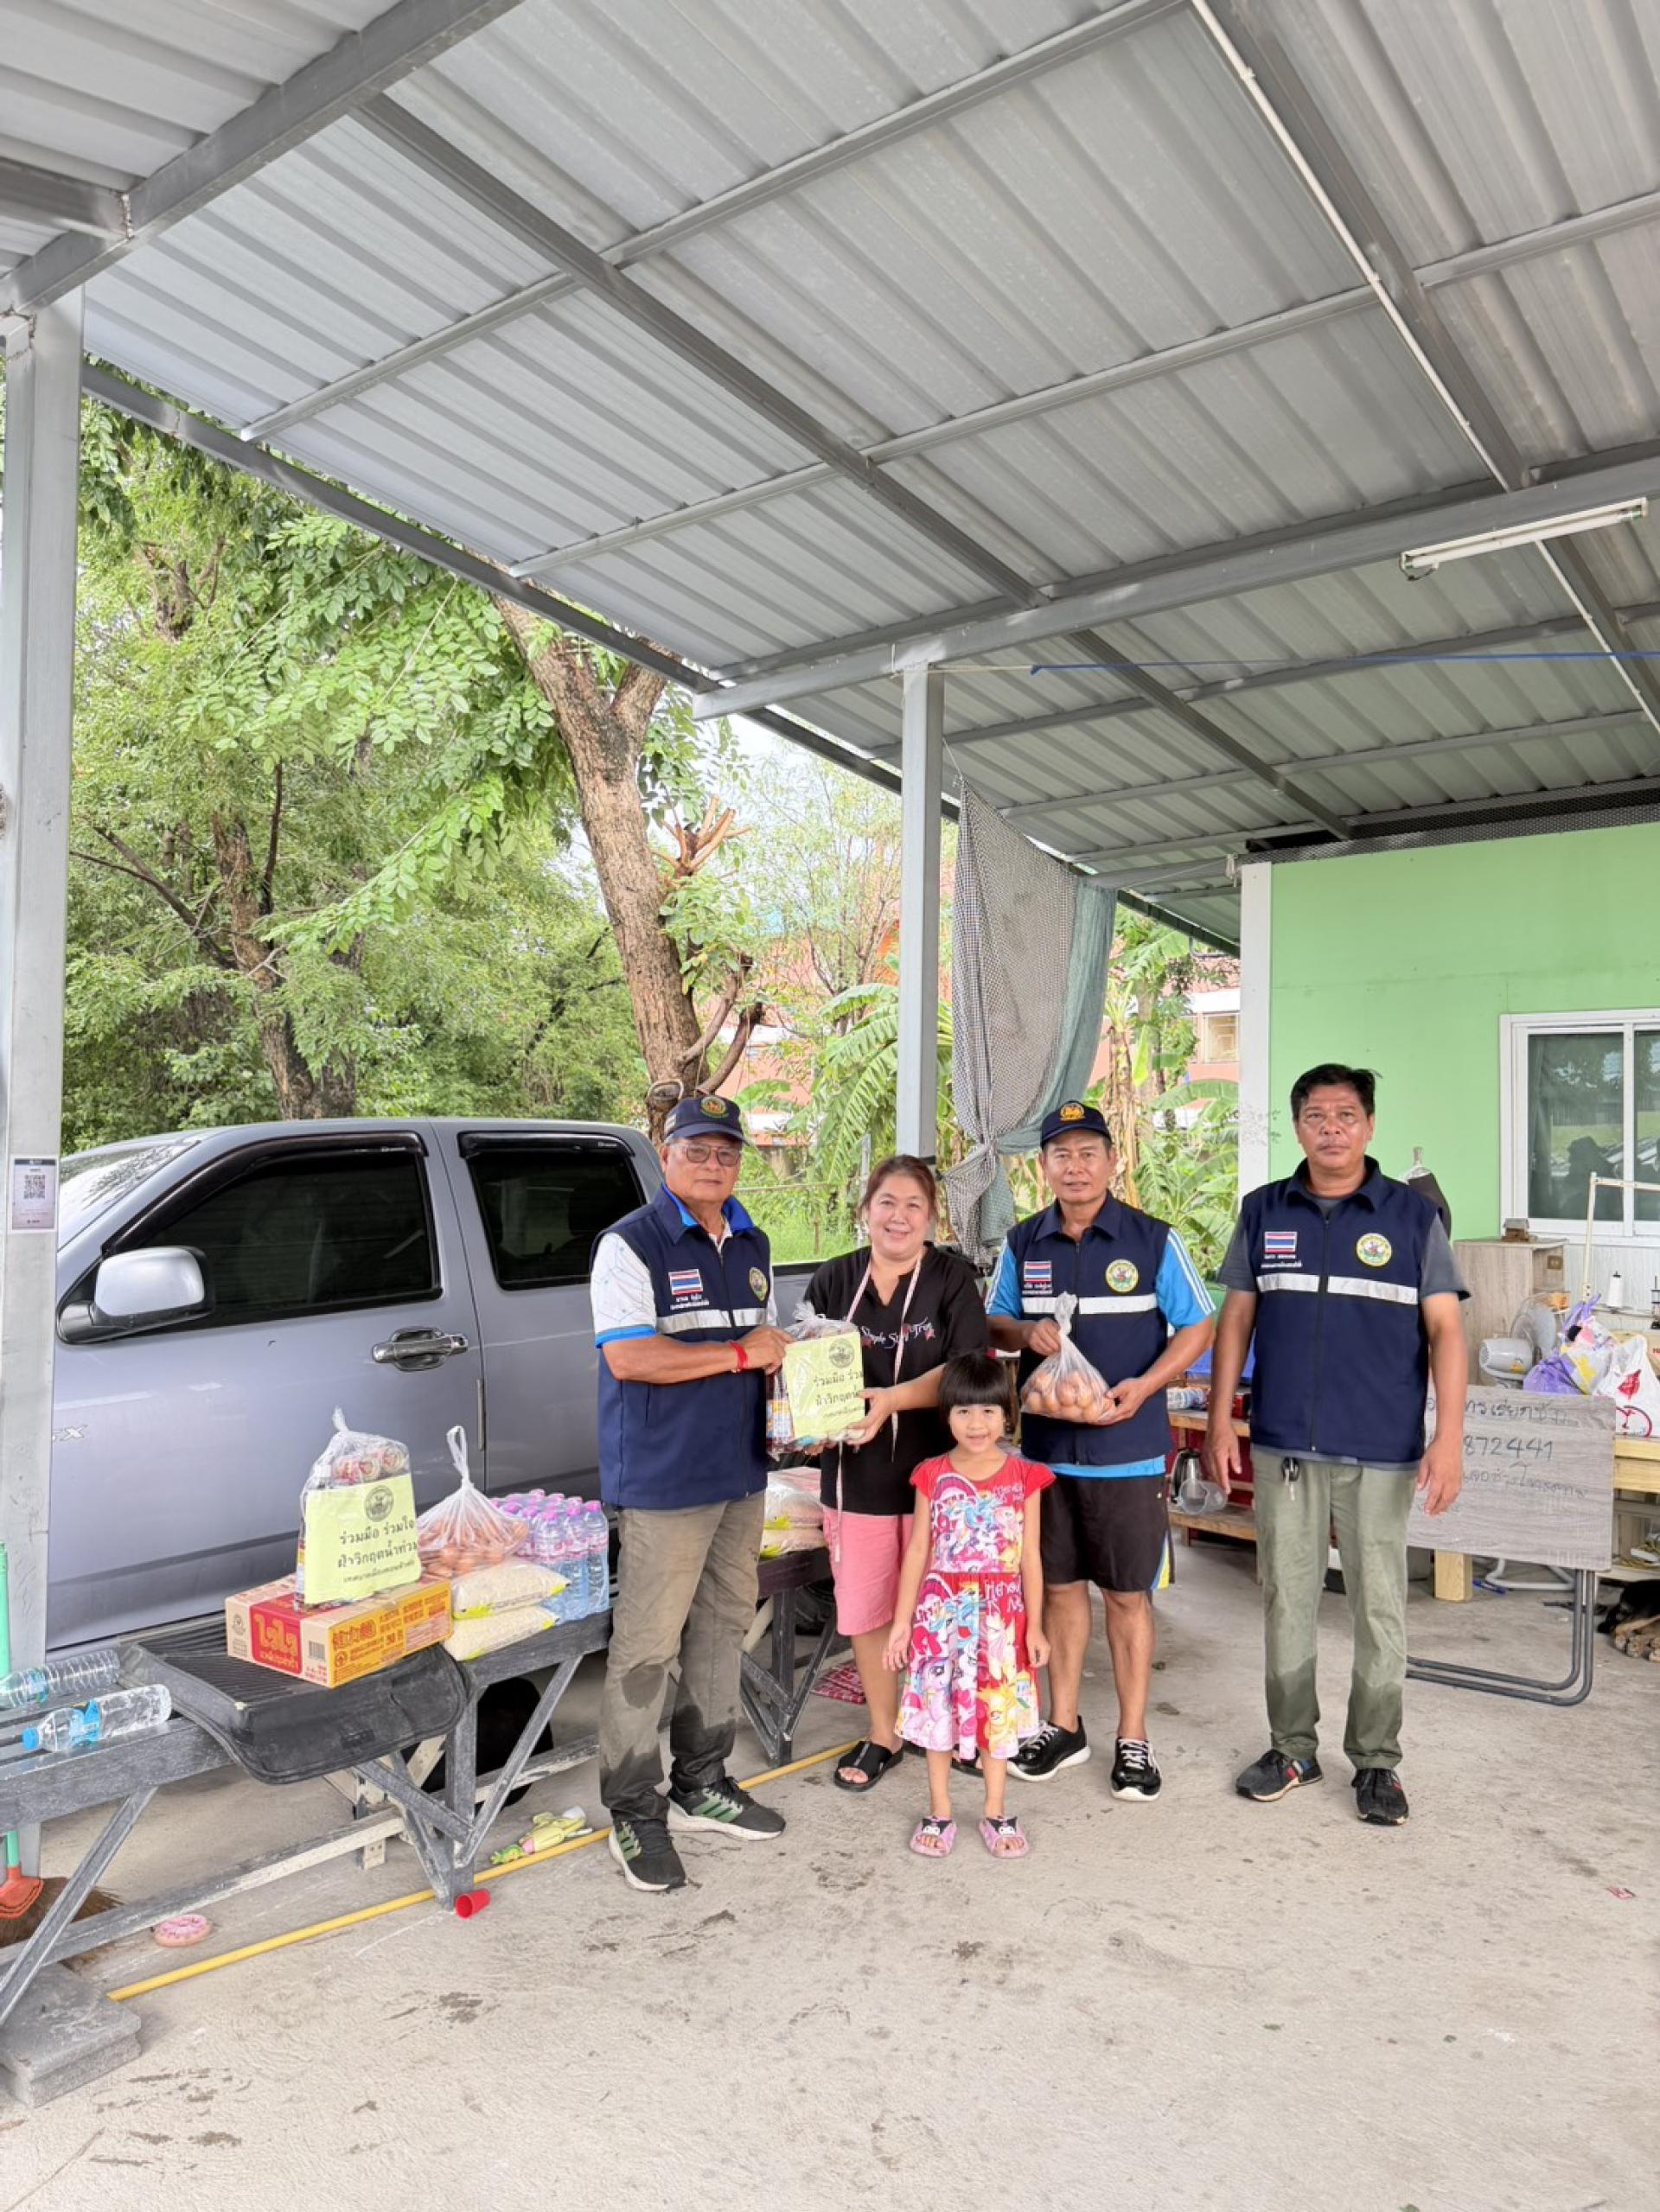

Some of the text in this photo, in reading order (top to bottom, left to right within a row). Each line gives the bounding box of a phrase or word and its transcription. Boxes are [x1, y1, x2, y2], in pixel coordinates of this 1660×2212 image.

[339, 1514, 415, 1545] ร่วมมือ ร่วมใจ
[252, 1613, 298, 1657] ไวไว
